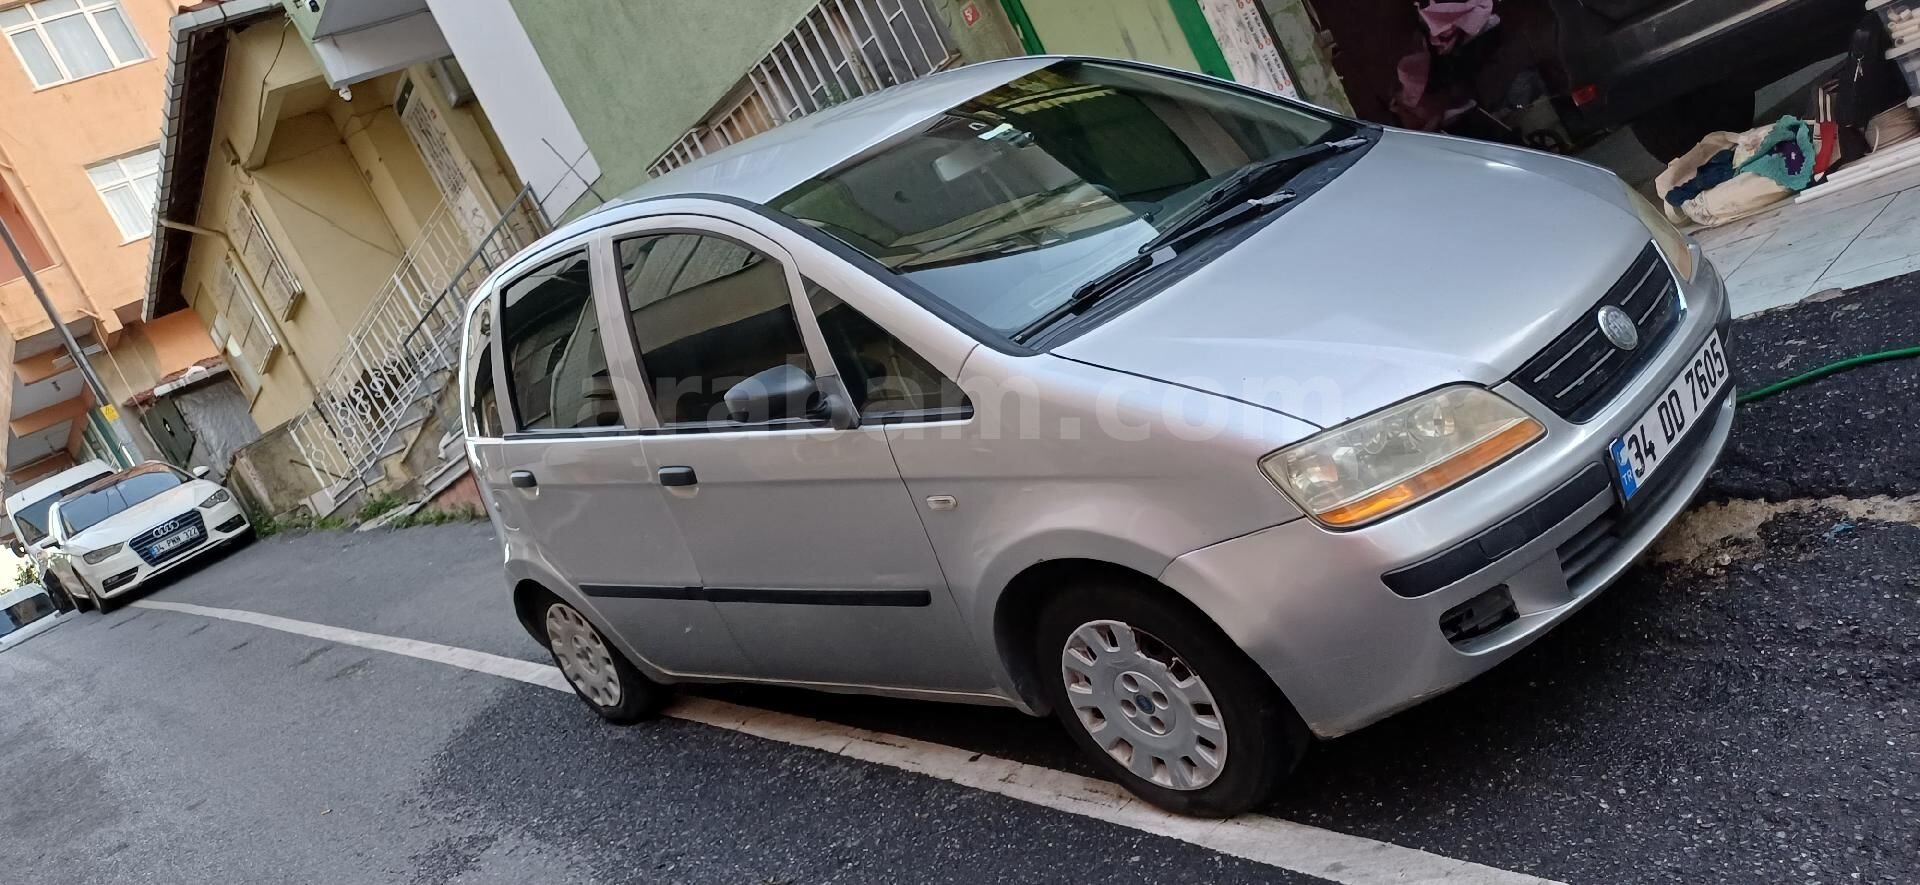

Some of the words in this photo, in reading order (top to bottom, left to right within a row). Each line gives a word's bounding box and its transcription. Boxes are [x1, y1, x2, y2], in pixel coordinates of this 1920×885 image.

[1627, 424, 1657, 479] 34
[1657, 389, 1686, 445] DD
[1684, 337, 1726, 414] 7605
[1622, 470, 1633, 486] TR
